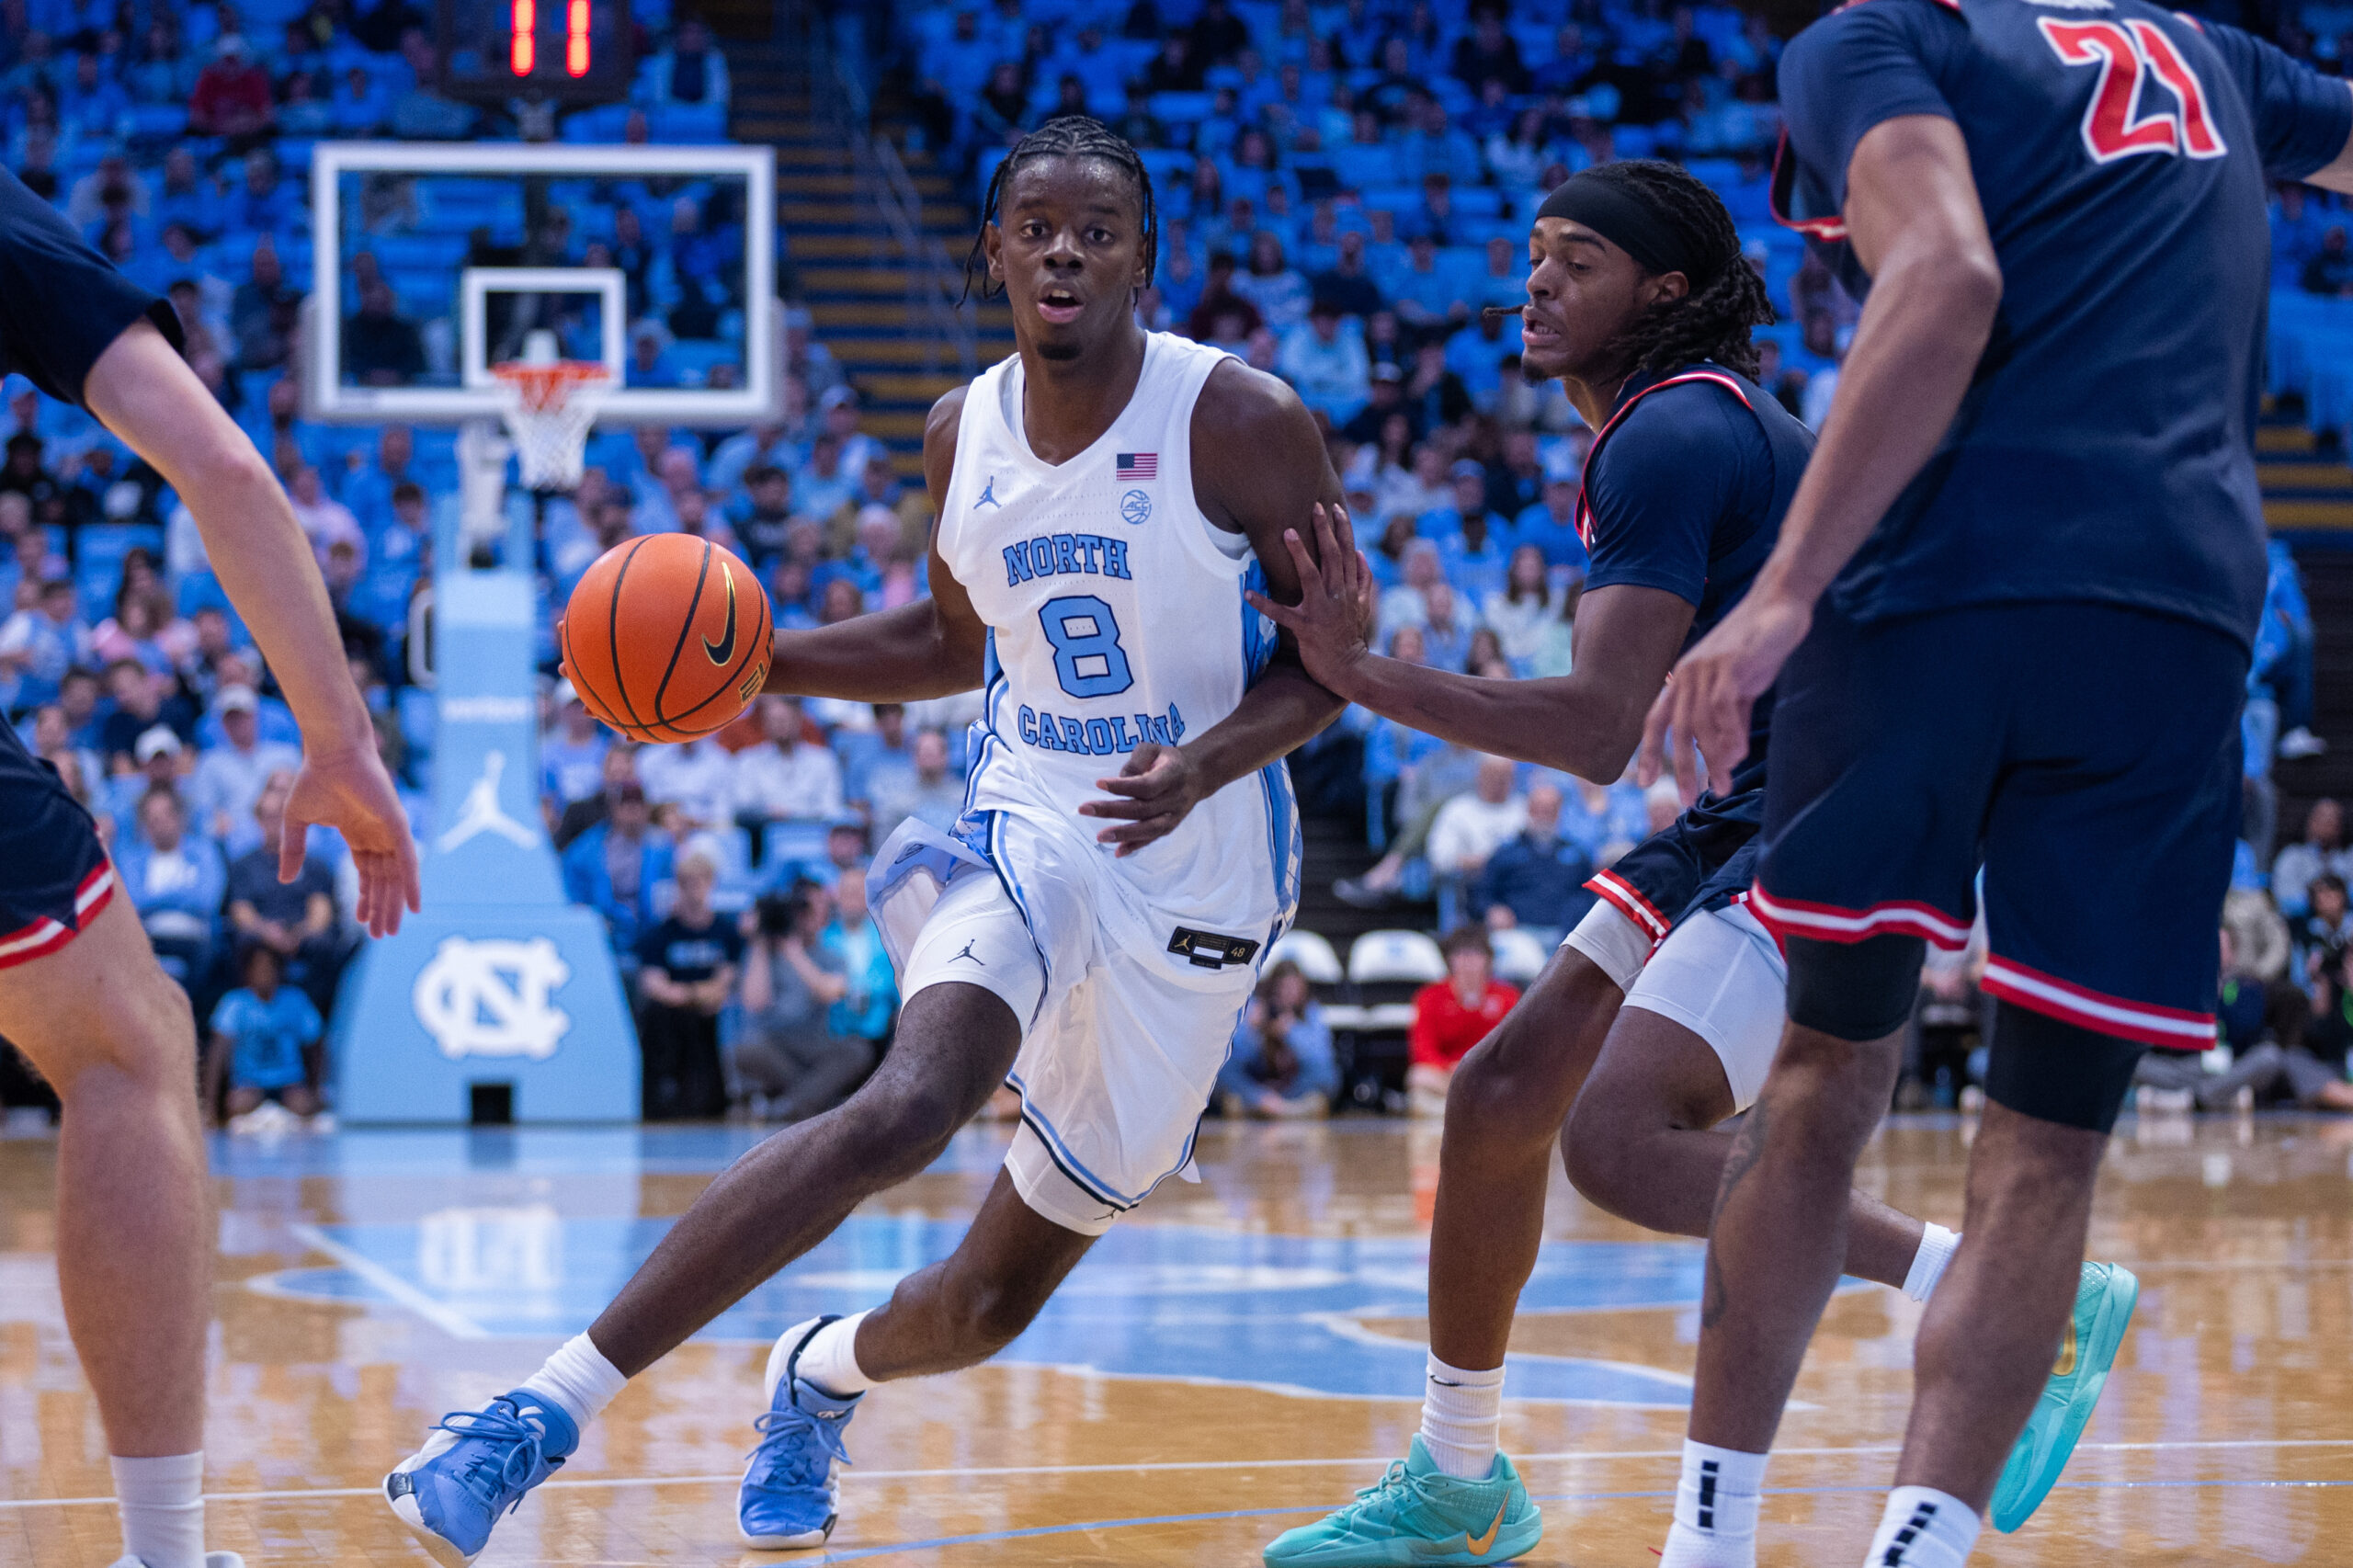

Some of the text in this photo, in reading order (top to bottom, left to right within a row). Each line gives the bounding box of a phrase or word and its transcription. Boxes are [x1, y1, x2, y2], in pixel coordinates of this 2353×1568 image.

[2036, 16, 2228, 165] 21
[1002, 533, 1132, 587] NORTH
[1038, 595, 1134, 699] 8
[1017, 702, 1186, 756] CAROLINA
[1231, 947, 1245, 958] 48
